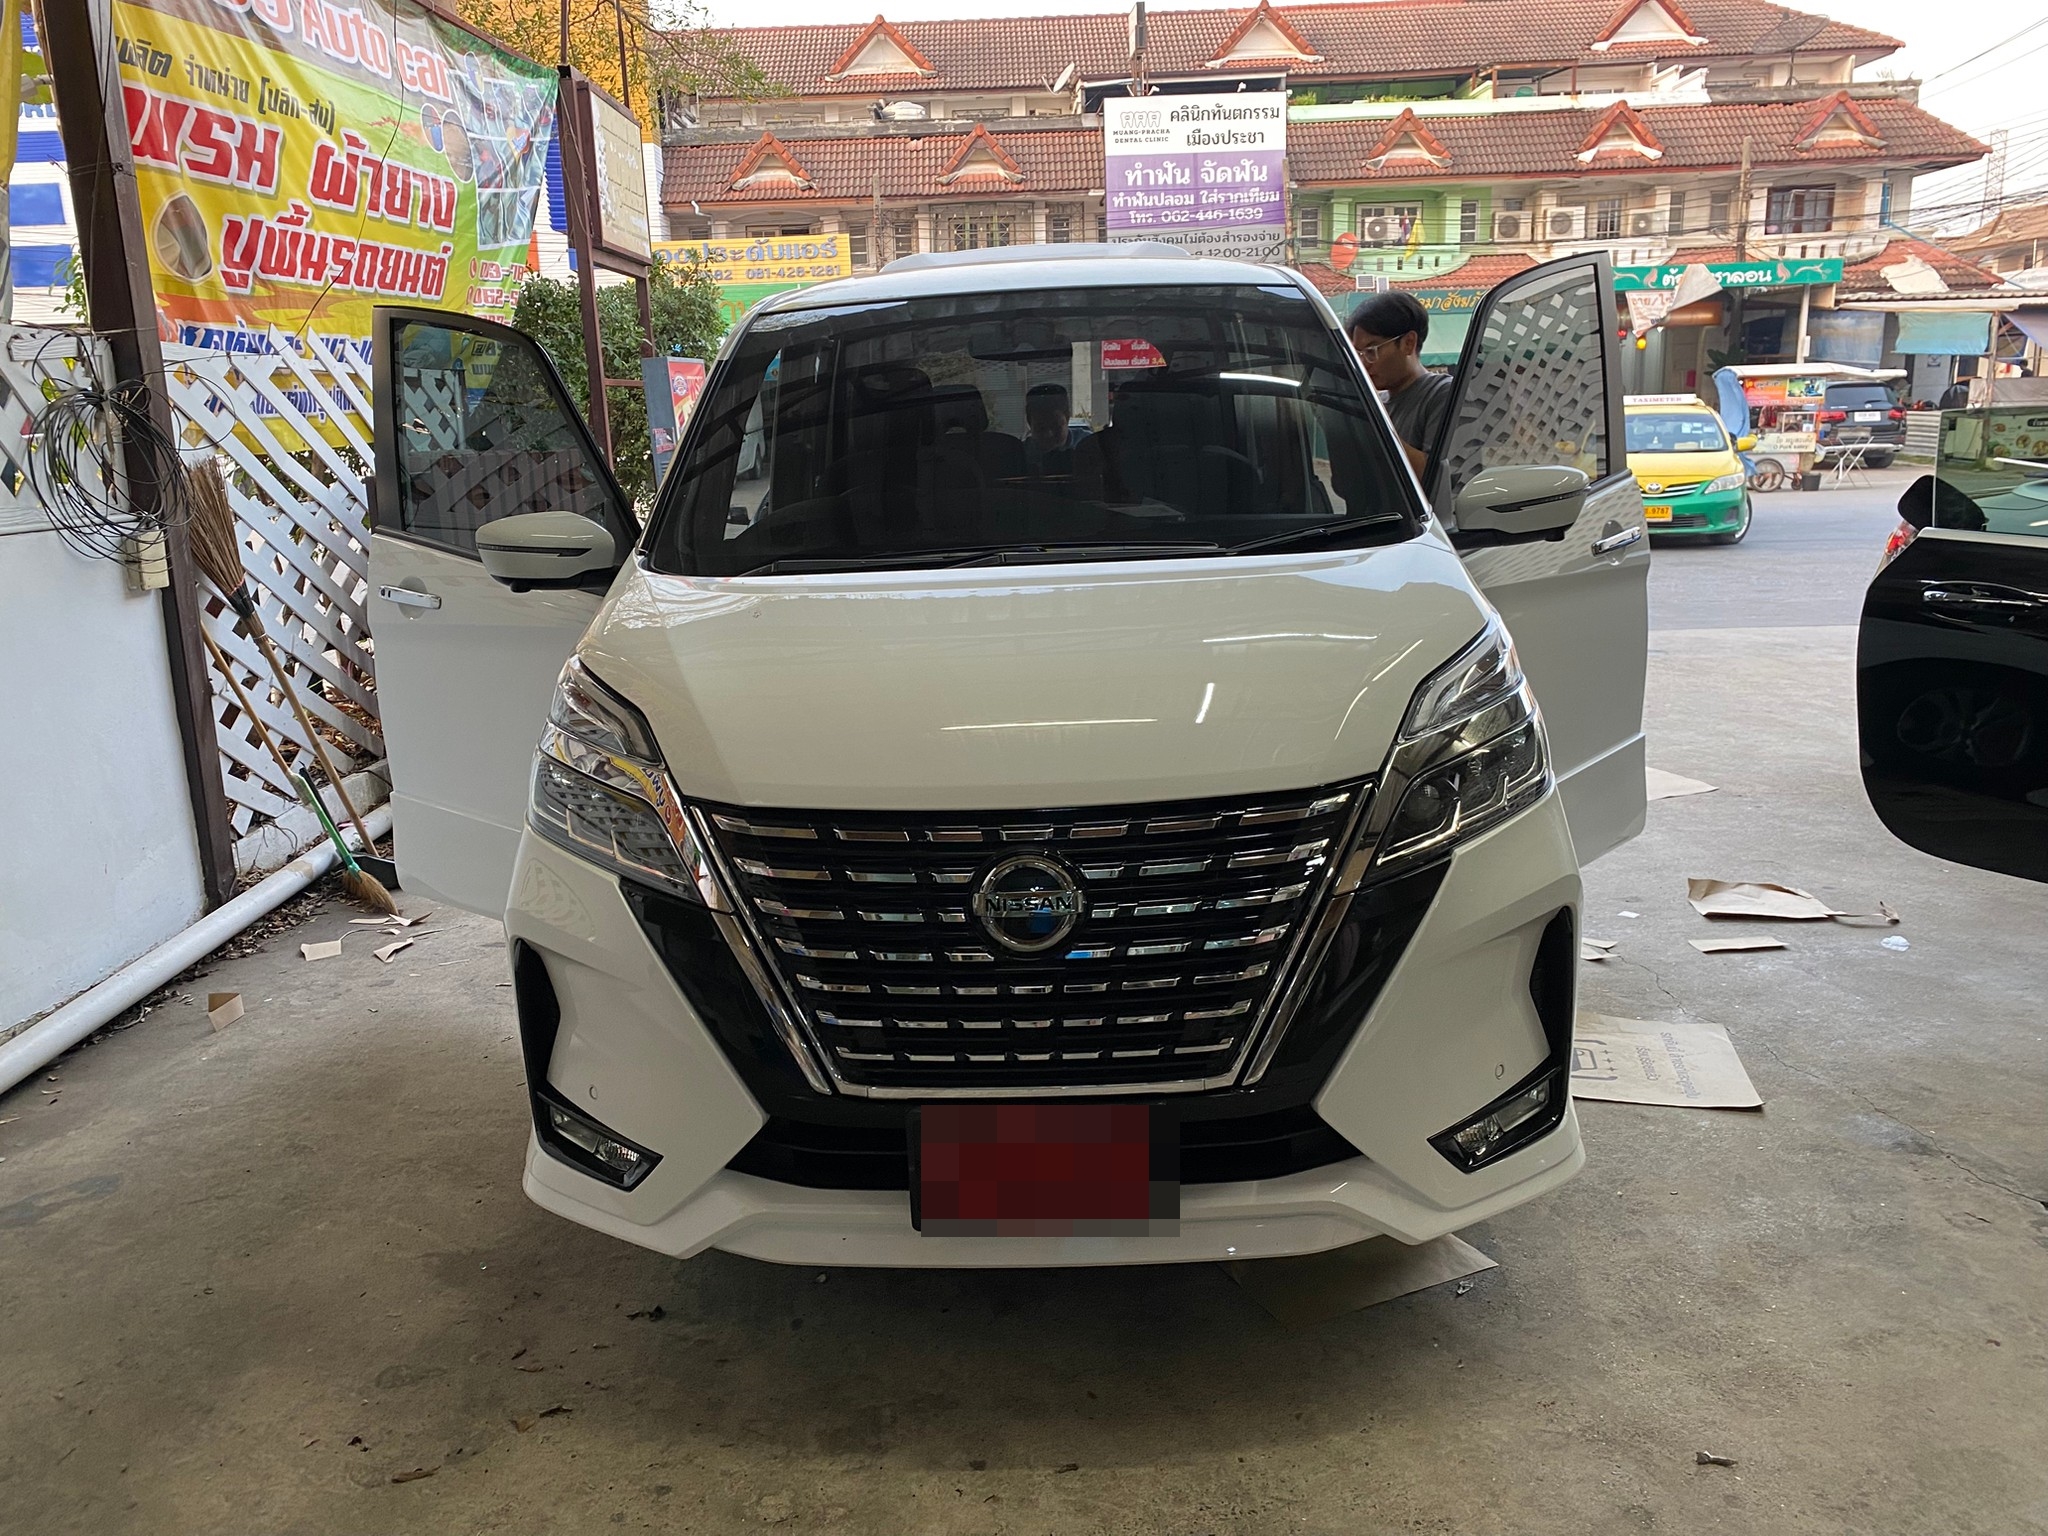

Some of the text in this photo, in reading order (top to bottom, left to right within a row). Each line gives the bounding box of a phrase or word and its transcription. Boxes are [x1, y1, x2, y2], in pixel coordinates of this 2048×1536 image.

[302, 0, 391, 78] Auto
[184, 54, 250, 103] จำหน่าย
[1170, 103, 1280, 122] คลินิกทันตกรรม
[1186, 129, 1265, 146] เมืองประชา
[311, 132, 456, 228] ผ้ายาง
[1125, 158, 1268, 186] ทำฟัน จัดฟัน
[1112, 190, 1195, 207] ทำฟันปลอม
[221, 202, 452, 296] ปูพื้นรถยนต์
[985, 896, 1072, 912] NISSAN
